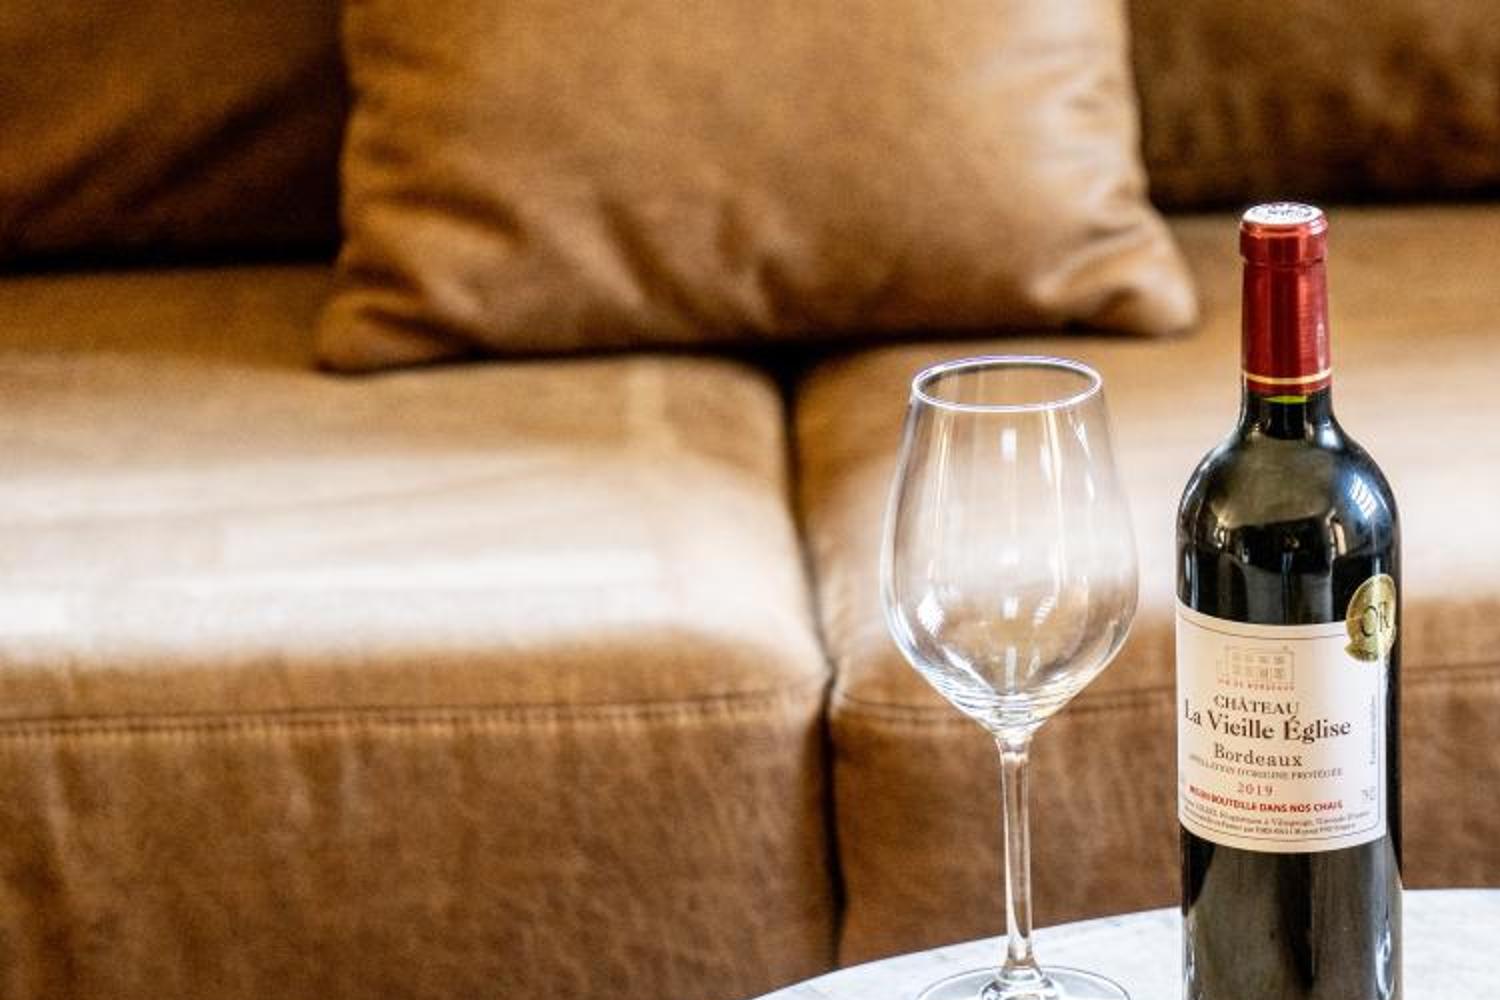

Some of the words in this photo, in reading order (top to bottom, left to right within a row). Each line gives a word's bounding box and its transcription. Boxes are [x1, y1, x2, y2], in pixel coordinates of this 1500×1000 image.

[1184, 698, 1202, 726] La
[1207, 709, 1275, 740] Vieille
[1282, 715, 1352, 745] Église
[1213, 742, 1303, 767] Bordeaux
[1237, 781, 1274, 797] 2019
[1259, 802, 1288, 813] DANS
[1289, 802, 1312, 813] NOS
